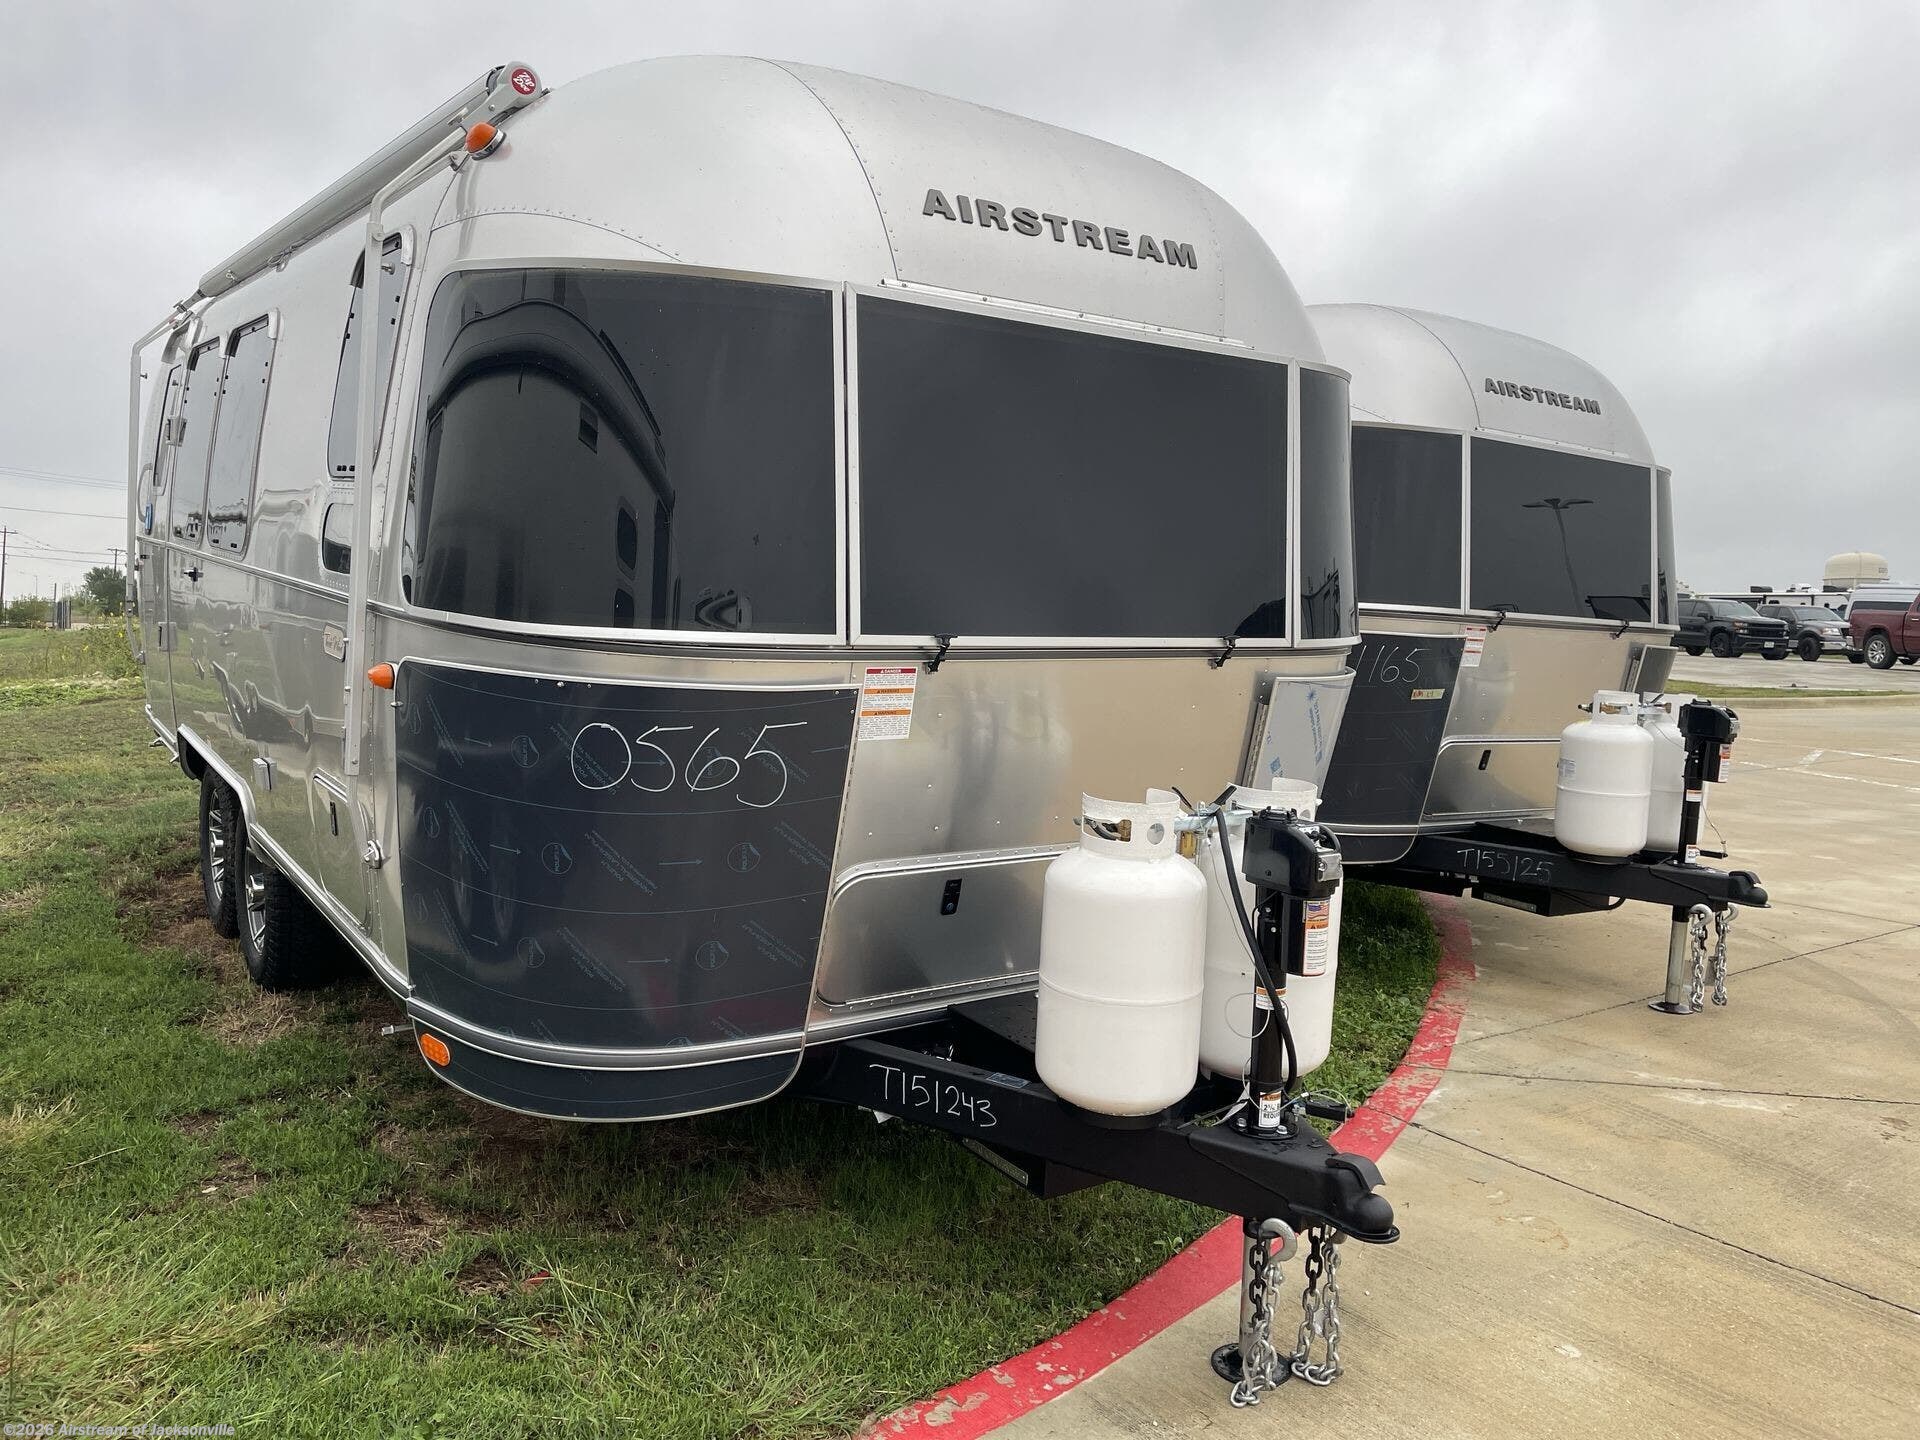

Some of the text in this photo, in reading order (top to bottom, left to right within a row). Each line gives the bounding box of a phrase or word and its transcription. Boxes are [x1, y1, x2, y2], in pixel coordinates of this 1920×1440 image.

[922, 188, 1198, 269] AIRSTREAM
[1484, 377, 1601, 415] AIRSTREAM
[571, 720, 808, 808] 0565
[869, 1063, 998, 1128] T151243
